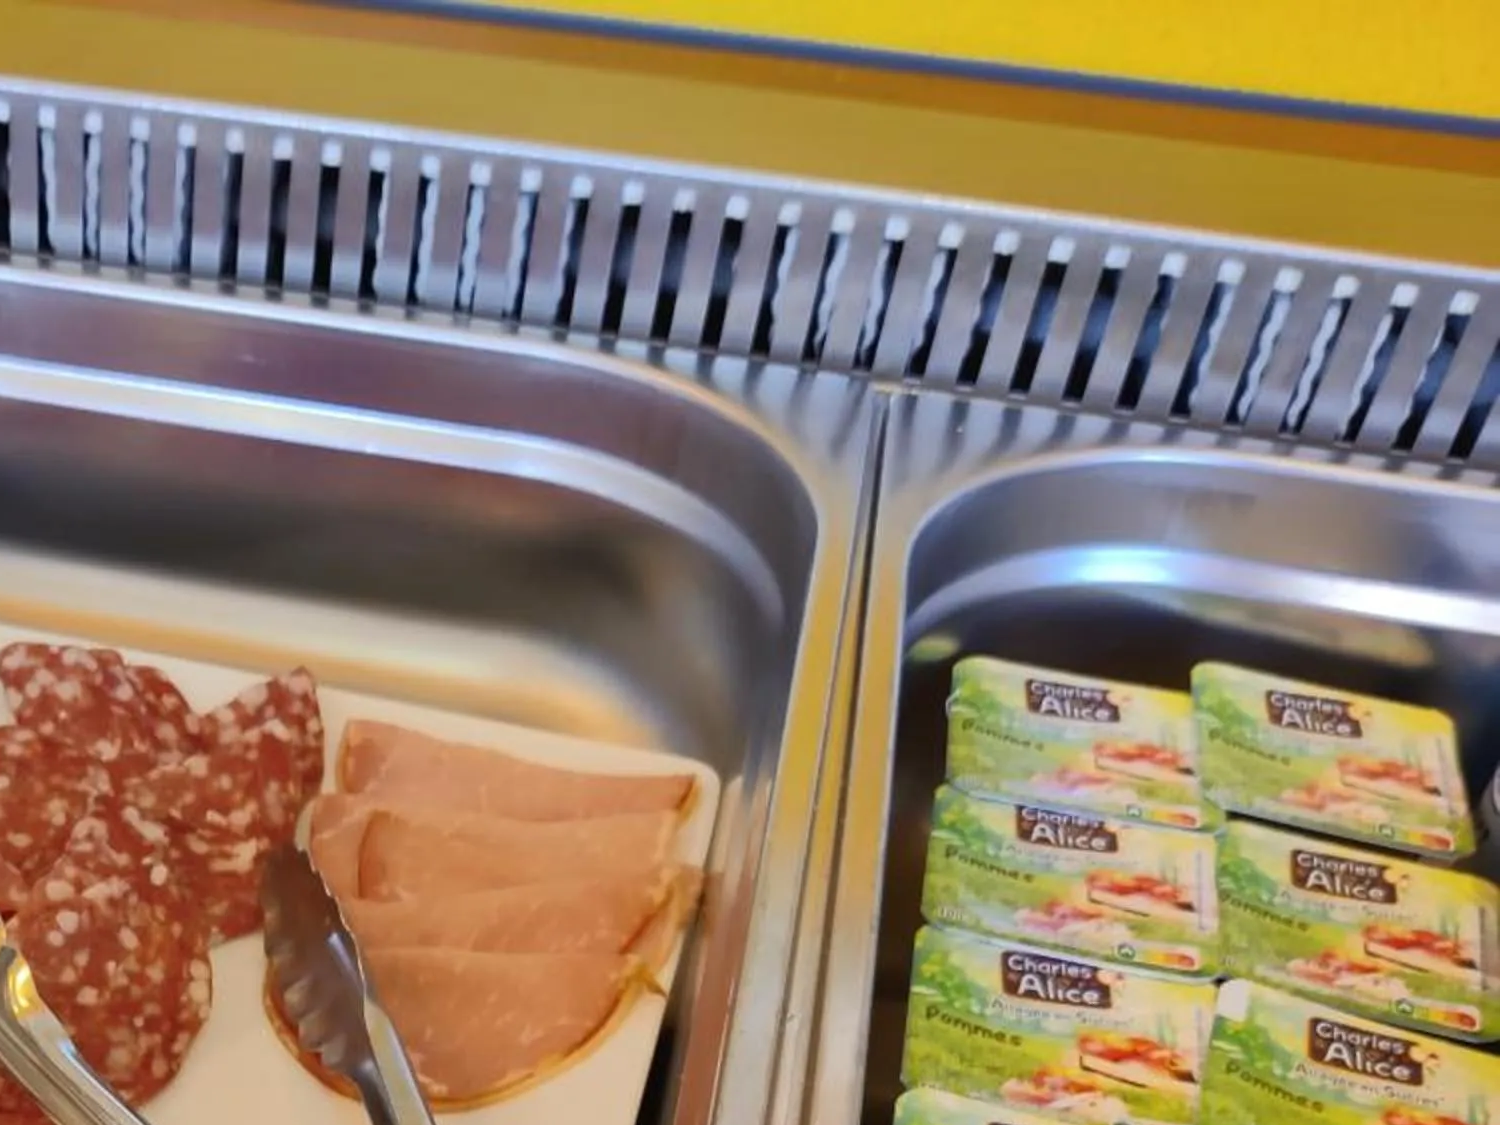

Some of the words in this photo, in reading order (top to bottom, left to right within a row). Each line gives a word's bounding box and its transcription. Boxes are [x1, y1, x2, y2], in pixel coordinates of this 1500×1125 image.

[1040, 696, 1112, 721] Alice
[1270, 693, 1344, 716] Charles
[1281, 708, 1355, 735] Alice
[1031, 824, 1108, 851] Alice
[1296, 853, 1379, 878] Charles
[1305, 870, 1386, 901] Alice
[1007, 954, 1093, 979] Charles
[1017, 973, 1100, 1006] Alice
[1315, 1021, 1405, 1054] Charles
[1324, 1042, 1413, 1081] Alice
[1224, 1059, 1325, 1114] Pommes
